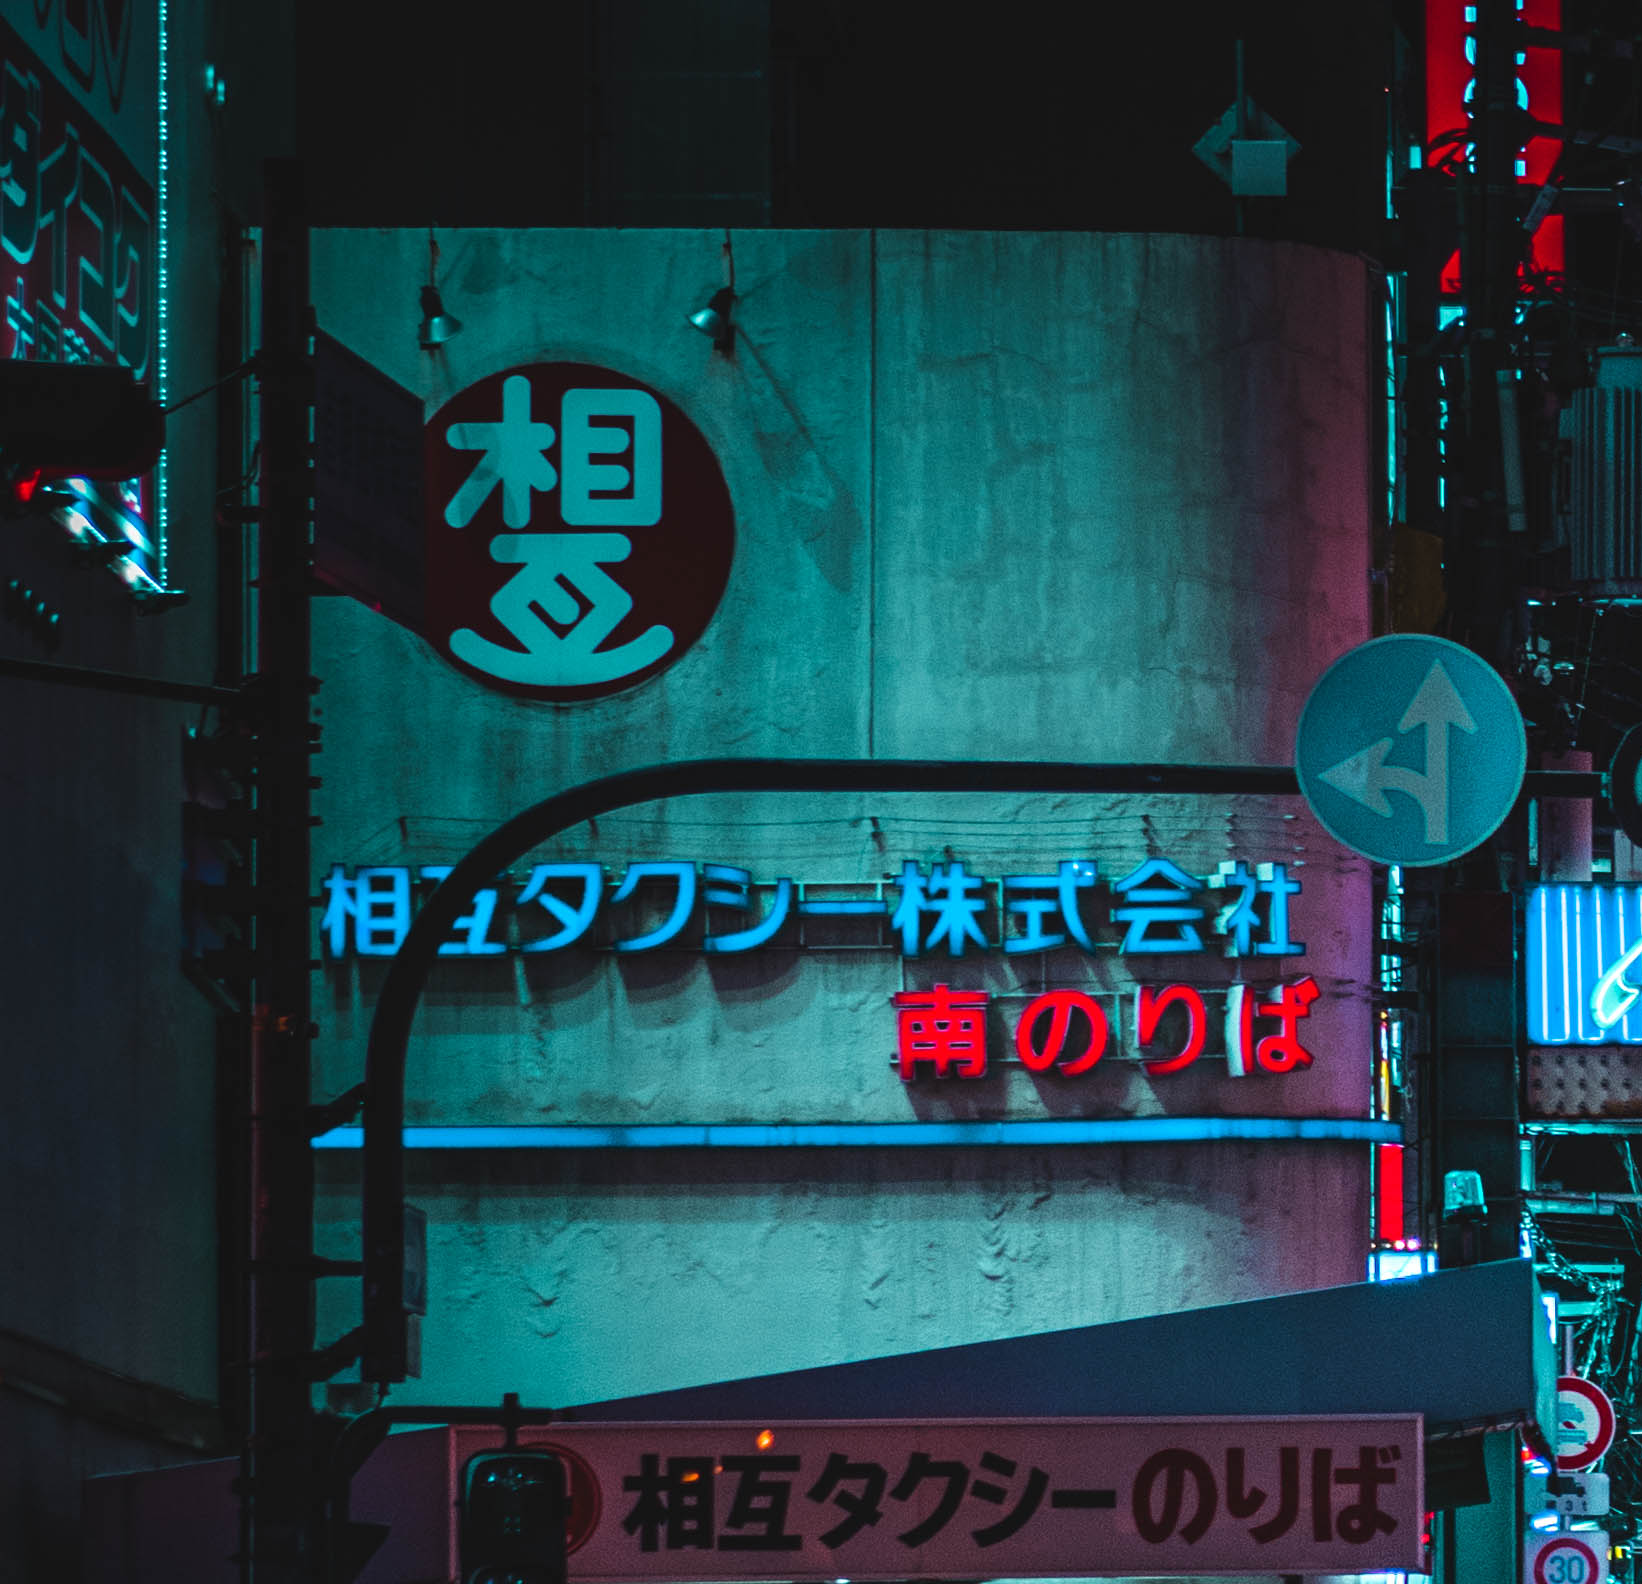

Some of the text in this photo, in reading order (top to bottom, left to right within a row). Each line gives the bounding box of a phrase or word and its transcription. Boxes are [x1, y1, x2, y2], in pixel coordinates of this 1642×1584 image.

[321, 859, 1305, 958] 相互タクシー株式会社
[893, 977, 1321, 1080] 南のりば
[622, 1446, 1400, 1550] 相互タクシーのりば
[1549, 1556, 1585, 1584] 30
